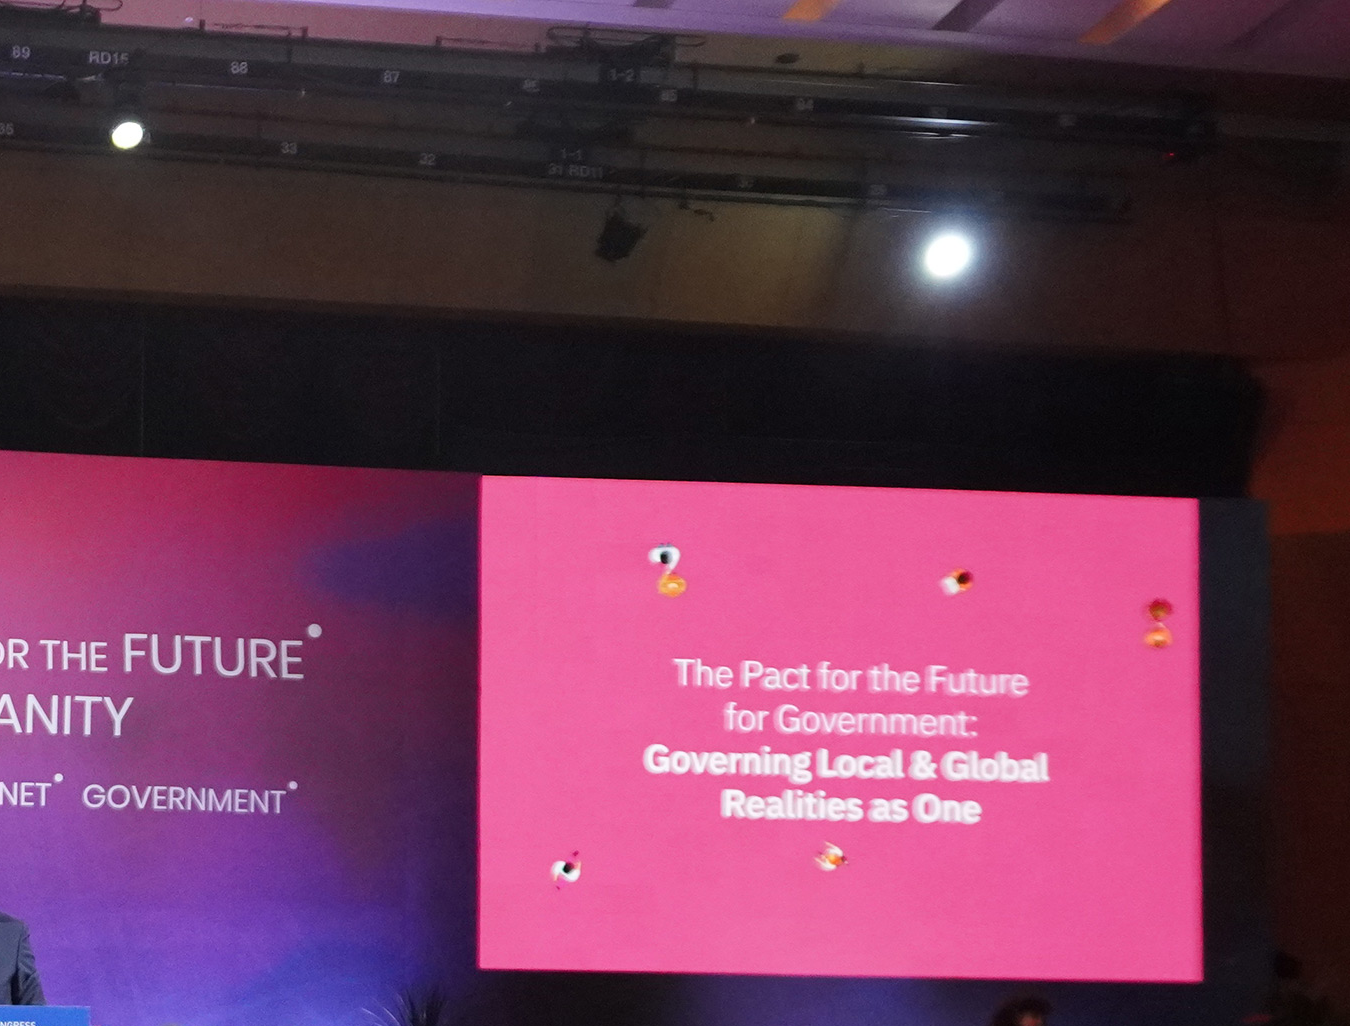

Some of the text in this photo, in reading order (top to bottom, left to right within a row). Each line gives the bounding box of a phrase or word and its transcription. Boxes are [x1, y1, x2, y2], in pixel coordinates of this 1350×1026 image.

[11, 45, 31, 60] 89
[40, 639, 108, 673] THE
[123, 633, 305, 681] FUTURE
[672, 658, 1030, 698] The Pact for the Future
[723, 702, 979, 738] for Government:
[643, 743, 1050, 785] Governing Local & Global
[82, 783, 287, 815] GOVERNMENT
[720, 788, 983, 825] Realities as One
